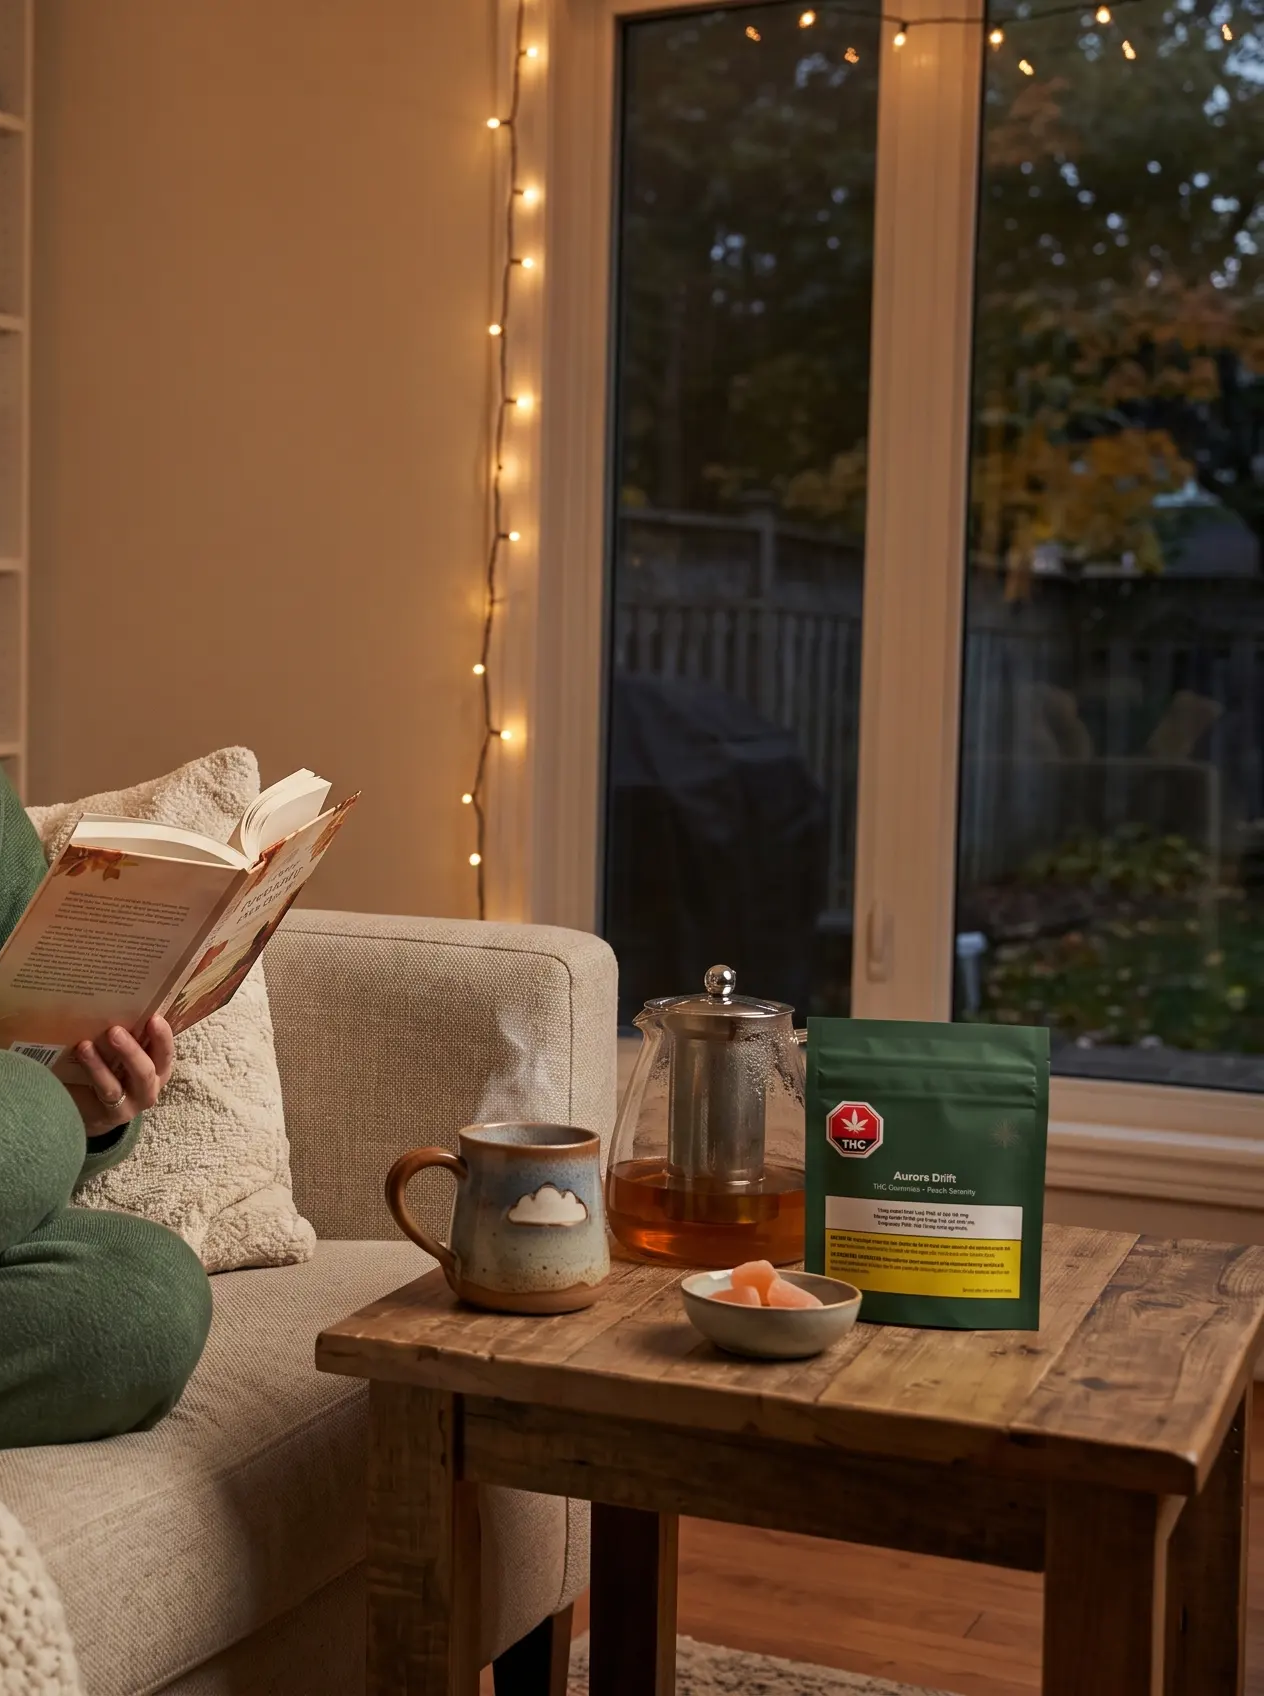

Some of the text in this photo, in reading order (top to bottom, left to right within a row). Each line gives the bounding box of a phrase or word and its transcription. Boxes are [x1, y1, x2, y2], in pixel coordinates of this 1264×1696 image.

[842, 1139, 866, 1150] THC
[893, 1171, 930, 1182] Aurors
[873, 1183, 887, 1191] THC
